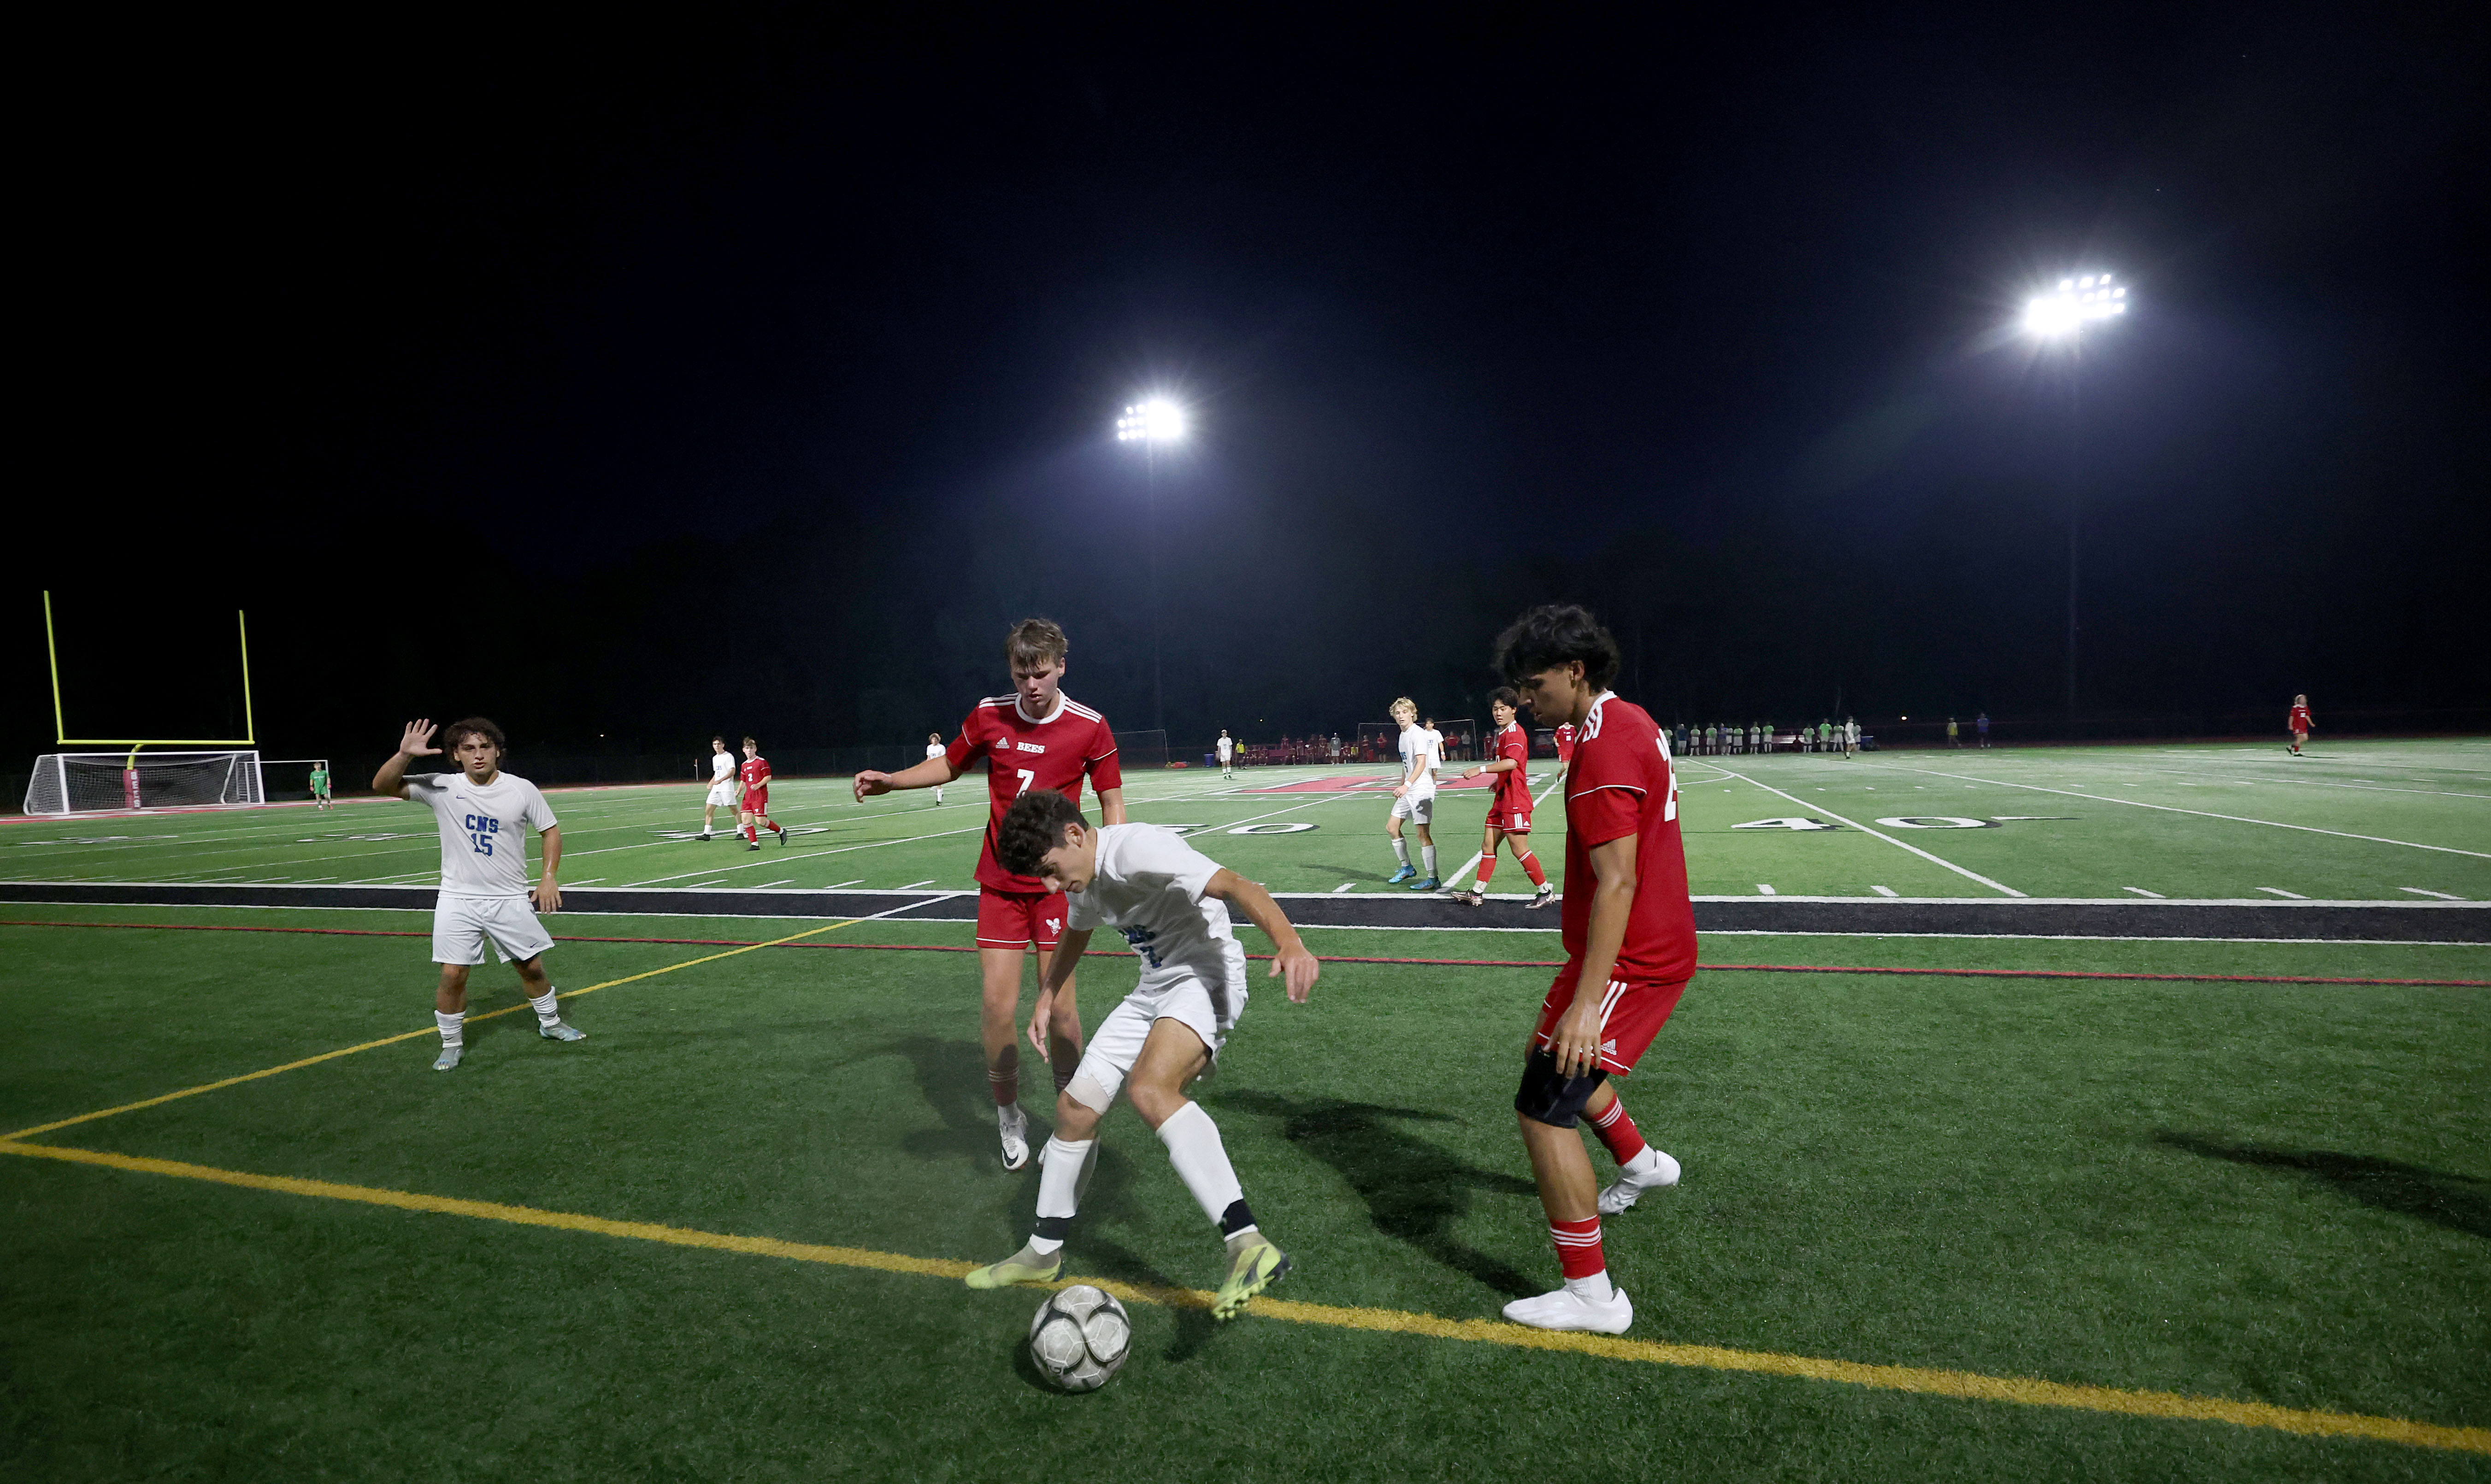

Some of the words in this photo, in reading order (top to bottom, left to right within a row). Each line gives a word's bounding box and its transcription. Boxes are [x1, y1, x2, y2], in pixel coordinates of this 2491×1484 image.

[1016, 741, 1045, 754] BEES
[748, 773, 753, 781] 2
[1016, 768, 1035, 798] 7
[130, 771, 141, 808] BEES
[465, 814, 498, 833] CNS
[471, 833, 493, 856] 15
